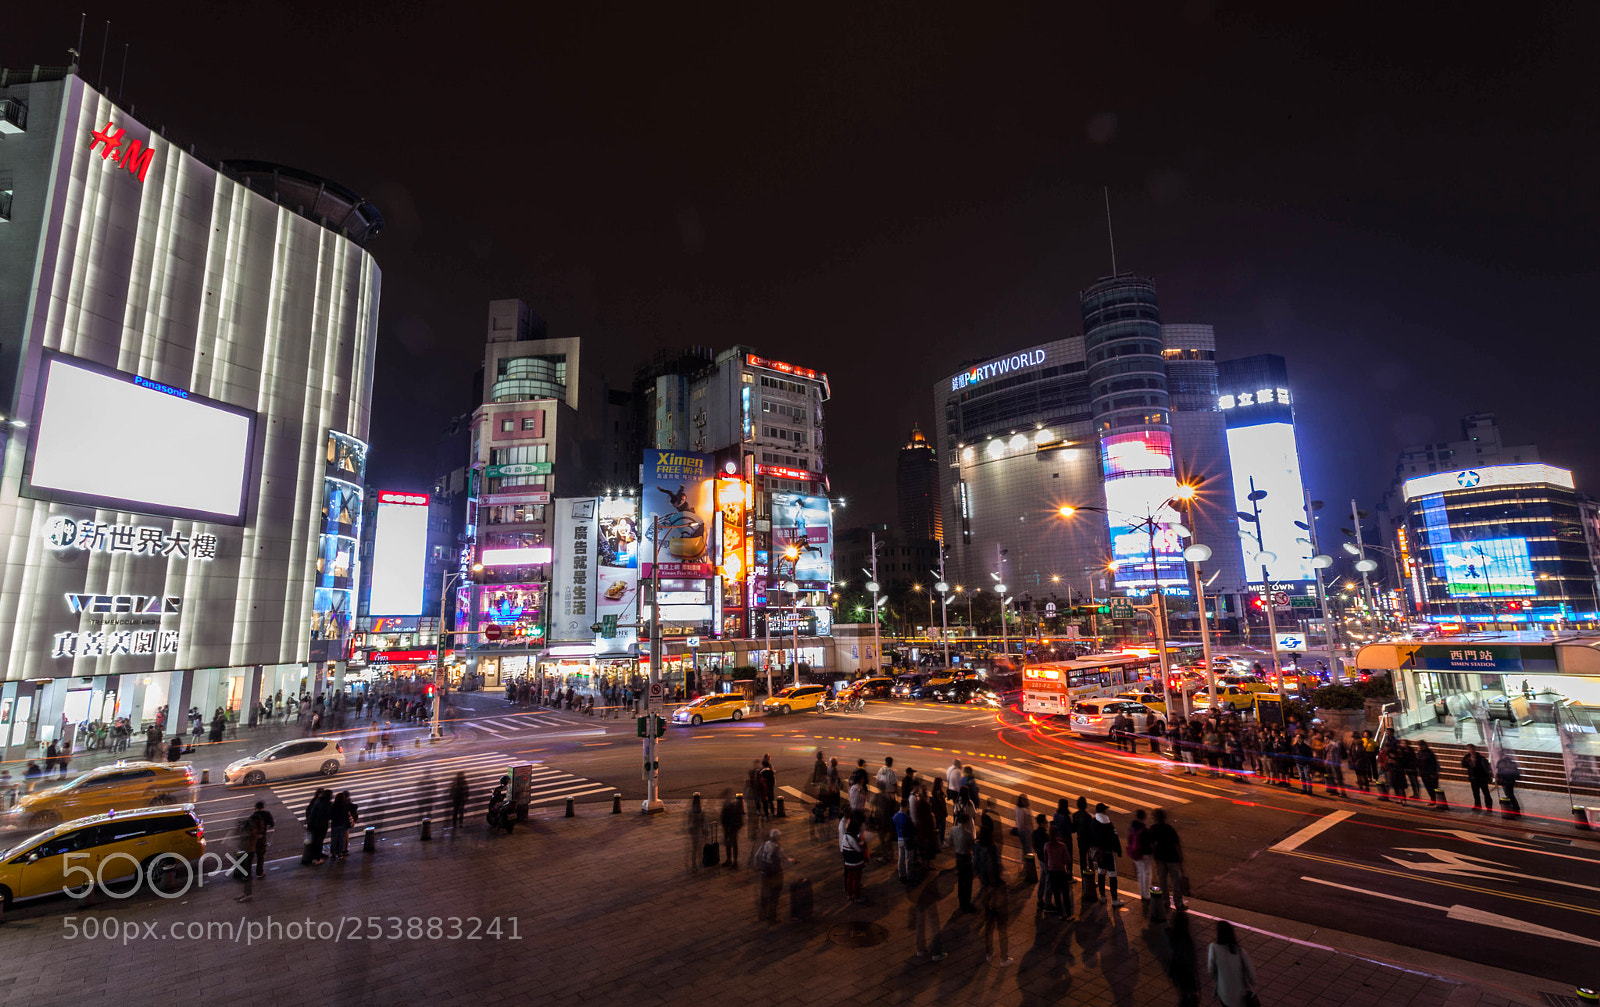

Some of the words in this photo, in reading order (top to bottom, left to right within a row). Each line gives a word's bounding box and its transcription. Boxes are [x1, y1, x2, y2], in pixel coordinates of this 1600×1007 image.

[89, 121, 156, 183] H&M
[778, 363, 794, 373] Taipei
[134, 375, 188, 399] Panasonic
[656, 452, 704, 468] Ximen
[656, 465, 681, 474] FREE
[683, 466, 703, 476] Wi-Fi
[78, 519, 218, 559] 新世界大樓
[573, 525, 588, 616] 廣告就是生活
[1248, 583, 1294, 592] MIDOWN
[64, 592, 182, 615] WESTAR
[1405, 650, 1416, 667] 1
[1449, 649, 1493, 661] 西門站
